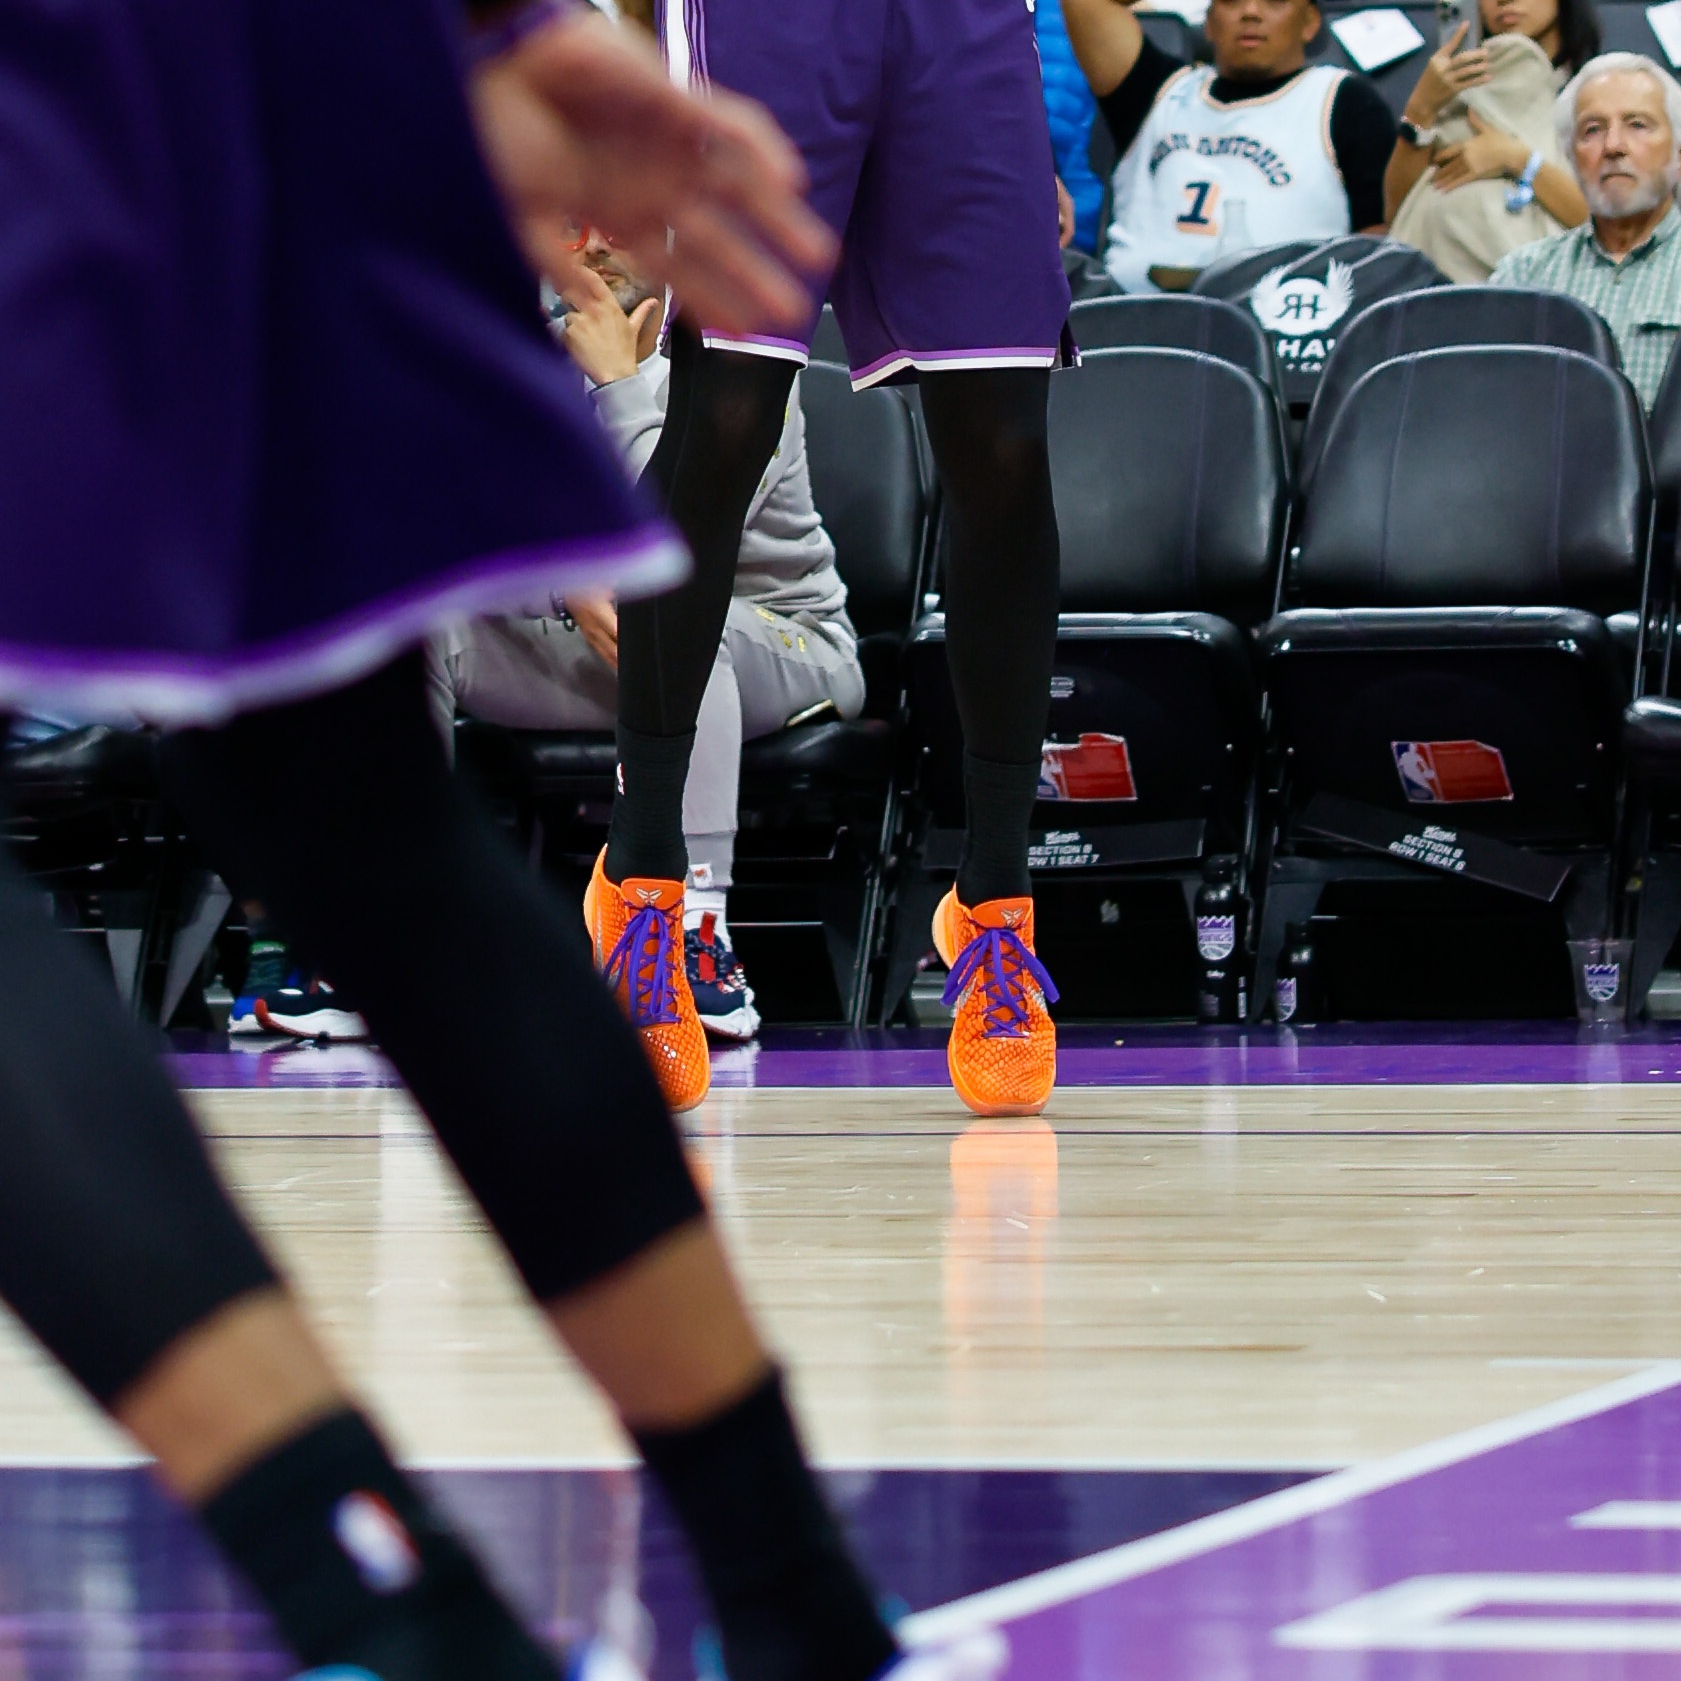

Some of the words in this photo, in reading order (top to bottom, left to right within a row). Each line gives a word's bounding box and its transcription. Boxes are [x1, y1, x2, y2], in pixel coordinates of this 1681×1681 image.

[1195, 134, 1292, 188] ANTONIO
[1175, 180, 1220, 236] 1
[1028, 845, 1080, 857] SECTION
[1388, 841, 1417, 857] ROW
[1425, 851, 1455, 869] SEAT
[1402, 834, 1452, 856] SECTION
[1027, 856, 1047, 867] OW
[1058, 854, 1089, 866] SEAT
